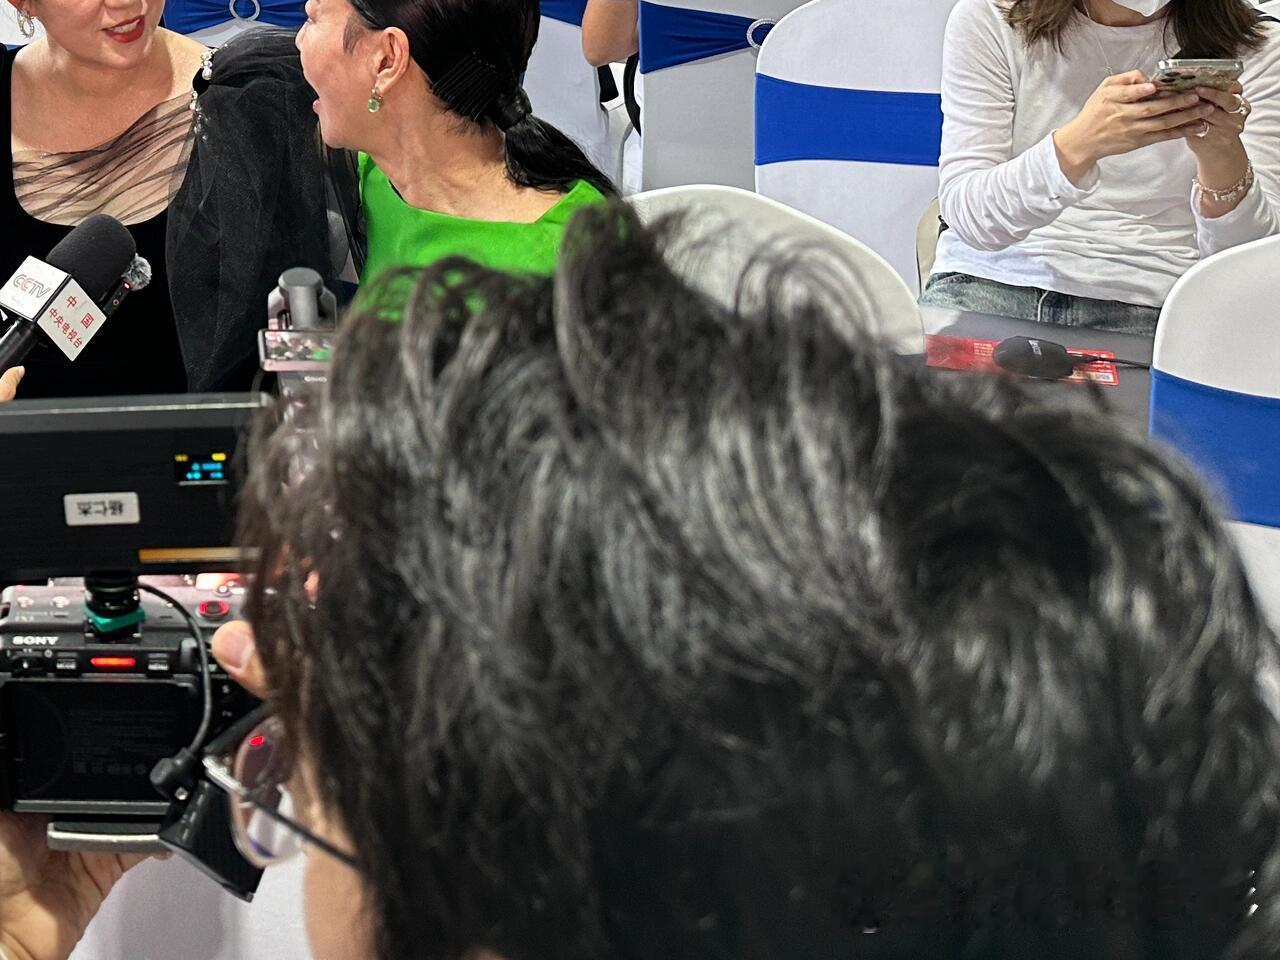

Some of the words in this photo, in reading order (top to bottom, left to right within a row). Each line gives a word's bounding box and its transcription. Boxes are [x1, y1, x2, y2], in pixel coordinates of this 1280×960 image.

[13, 274, 52, 298] CCTV
[49, 307, 83, 348] 中央电视台
[13, 635, 59, 645] SONY
